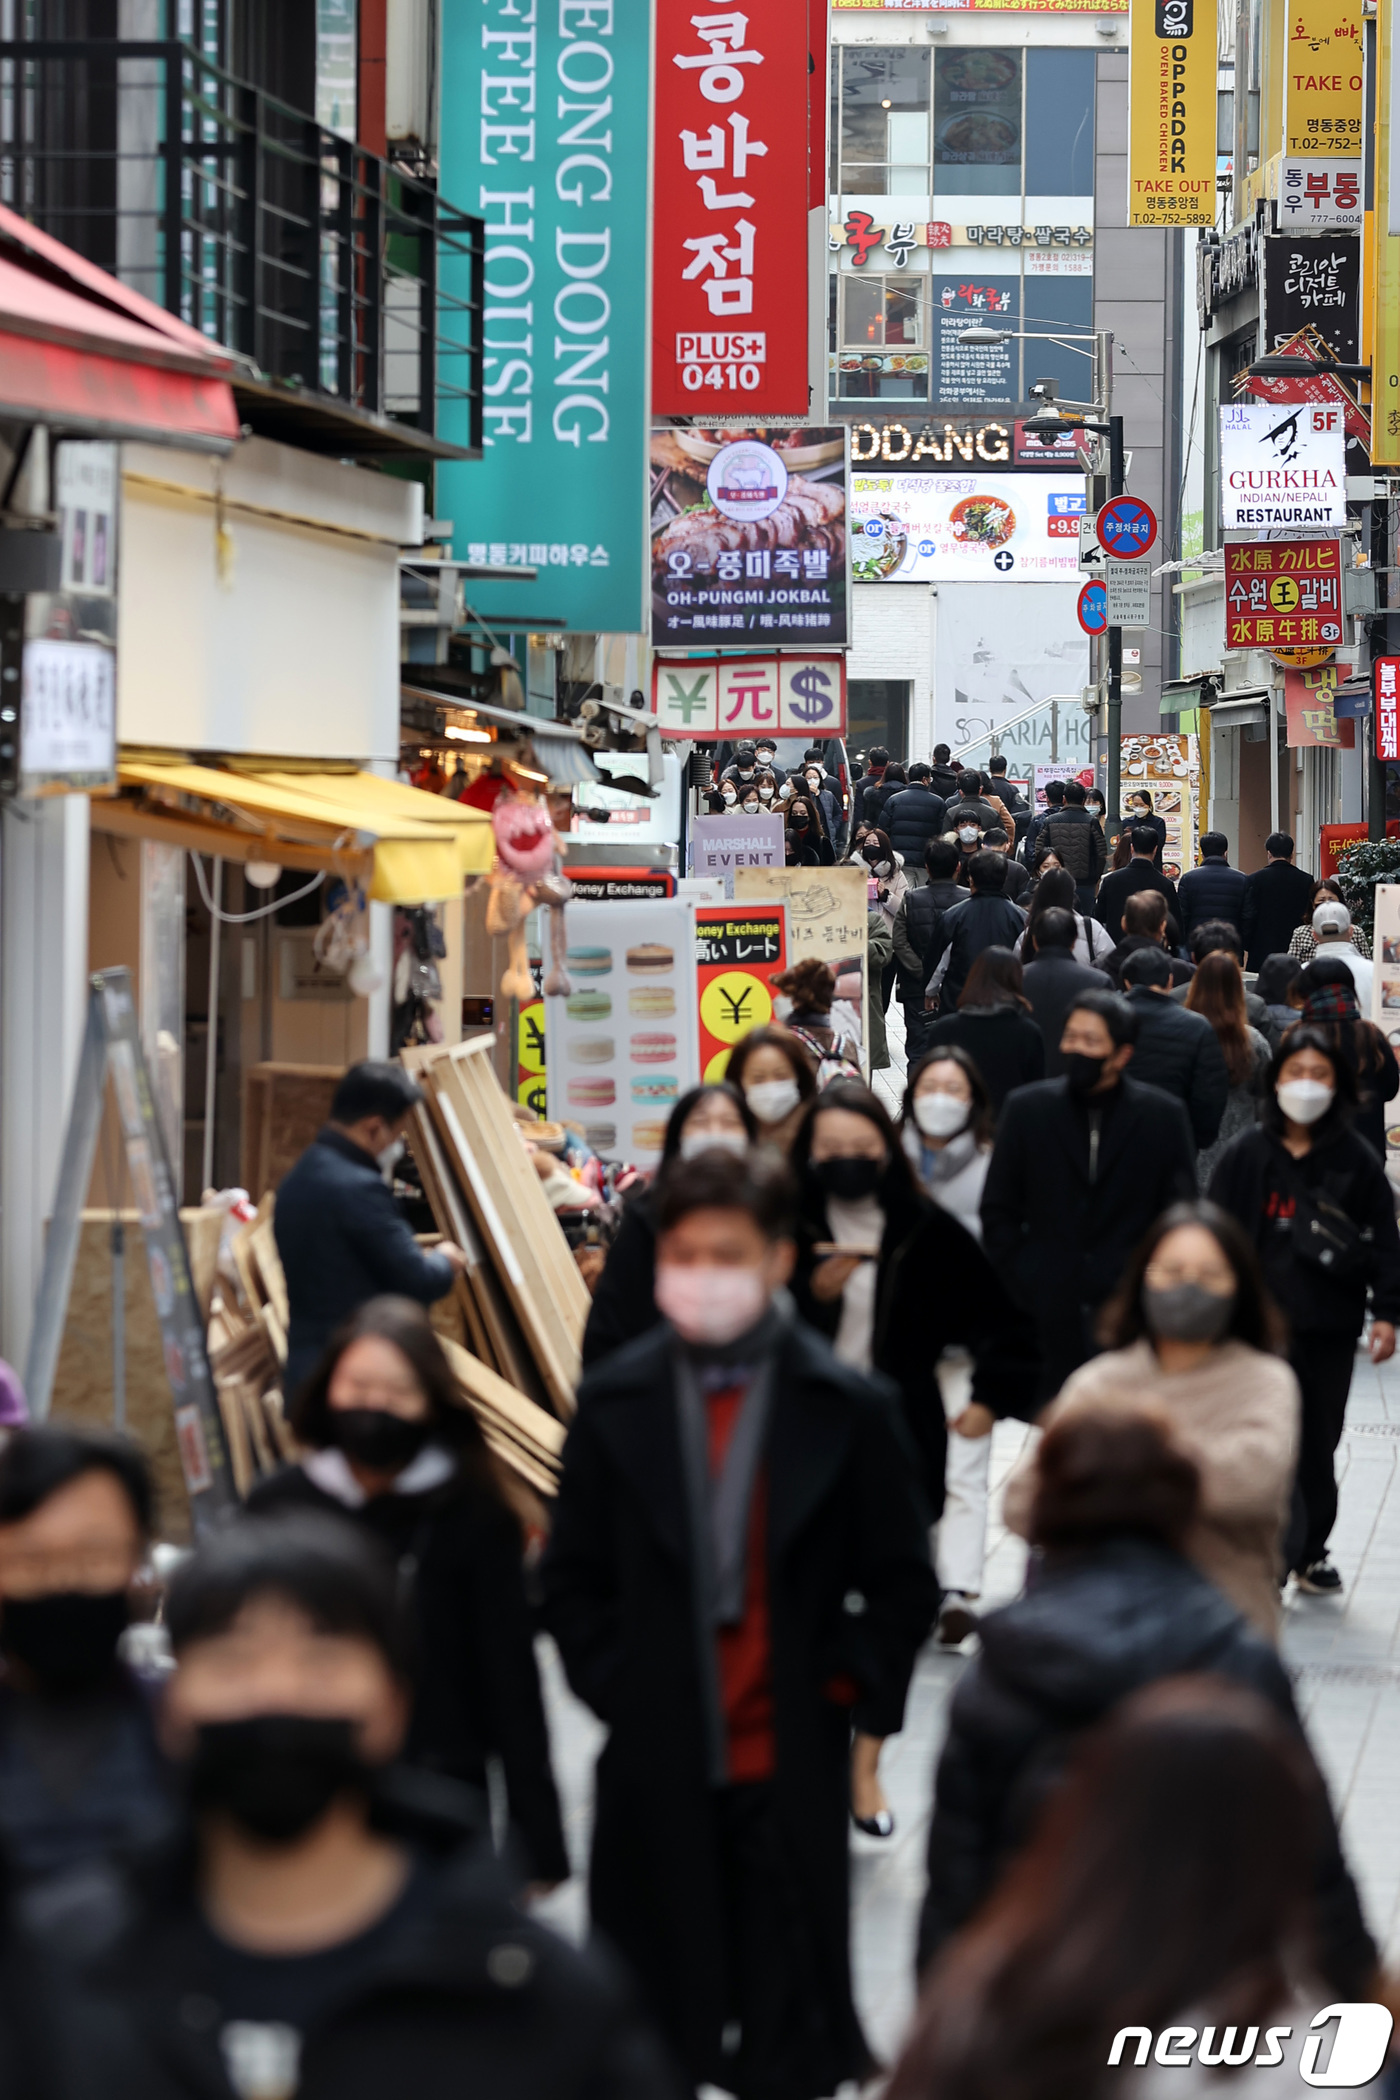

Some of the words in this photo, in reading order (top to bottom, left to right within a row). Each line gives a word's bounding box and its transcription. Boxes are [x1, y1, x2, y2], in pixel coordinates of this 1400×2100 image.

[1160, 46, 1168, 77] OVEN
[1293, 75, 1342, 91] TAKE
[1159, 81, 1168, 119] BAKED
[1171, 45, 1187, 173] OPPADAK
[672, 0, 768, 316] 콩반점
[1159, 122, 1168, 172] CHICKEN
[1134, 180, 1174, 193] TAKE
[1179, 180, 1211, 193] OUT
[1304, 172, 1360, 210] 부동
[1146, 196, 1199, 210] 명동중앙점
[1133, 213, 1212, 225] T.02-752-5892
[1289, 252, 1347, 274] 코리안
[1284, 276, 1340, 294] 디저트
[1300, 290, 1345, 309] 카페
[480, 185, 535, 446] HOUSE
[552, 227, 611, 447] DONG
[679, 335, 762, 359] PLUS+
[681, 363, 760, 391] 0410
[1312, 411, 1338, 431] 5F
[851, 422, 1009, 462] DDANG
[1229, 469, 1338, 490] GURKHA
[1054, 496, 1086, 512] 벌교
[1240, 492, 1328, 503] INDIAN/NEPALI
[1237, 508, 1333, 522] RESTAURANT
[867, 522, 882, 534] or
[1106, 522, 1149, 534] 주정차금지
[467, 542, 610, 567] 명동커피하우스
[918, 544, 935, 554] or
[1231, 548, 1273, 571] 水原
[1279, 547, 1336, 570] カルビ
[667, 590, 763, 606] OH-PUNGMI
[767, 589, 831, 605] JOKBAL
[1232, 618, 1319, 643] 水原牛排
[1323, 625, 1339, 638] 3F
[1296, 656, 1307, 665] 3F
[725, 671, 773, 722] 元
[788, 666, 833, 724] $
[1300, 666, 1341, 744] 냉면
[1380, 662, 1397, 758] 놀부부대찌개
[703, 837, 776, 851] MARSHALL
[707, 853, 773, 867] EVENT
[607, 882, 664, 897] Exchange
[696, 924, 724, 938] oney
[726, 922, 780, 938] Exchange
[736, 936, 778, 959] レート
[719, 985, 753, 1024] ¥
